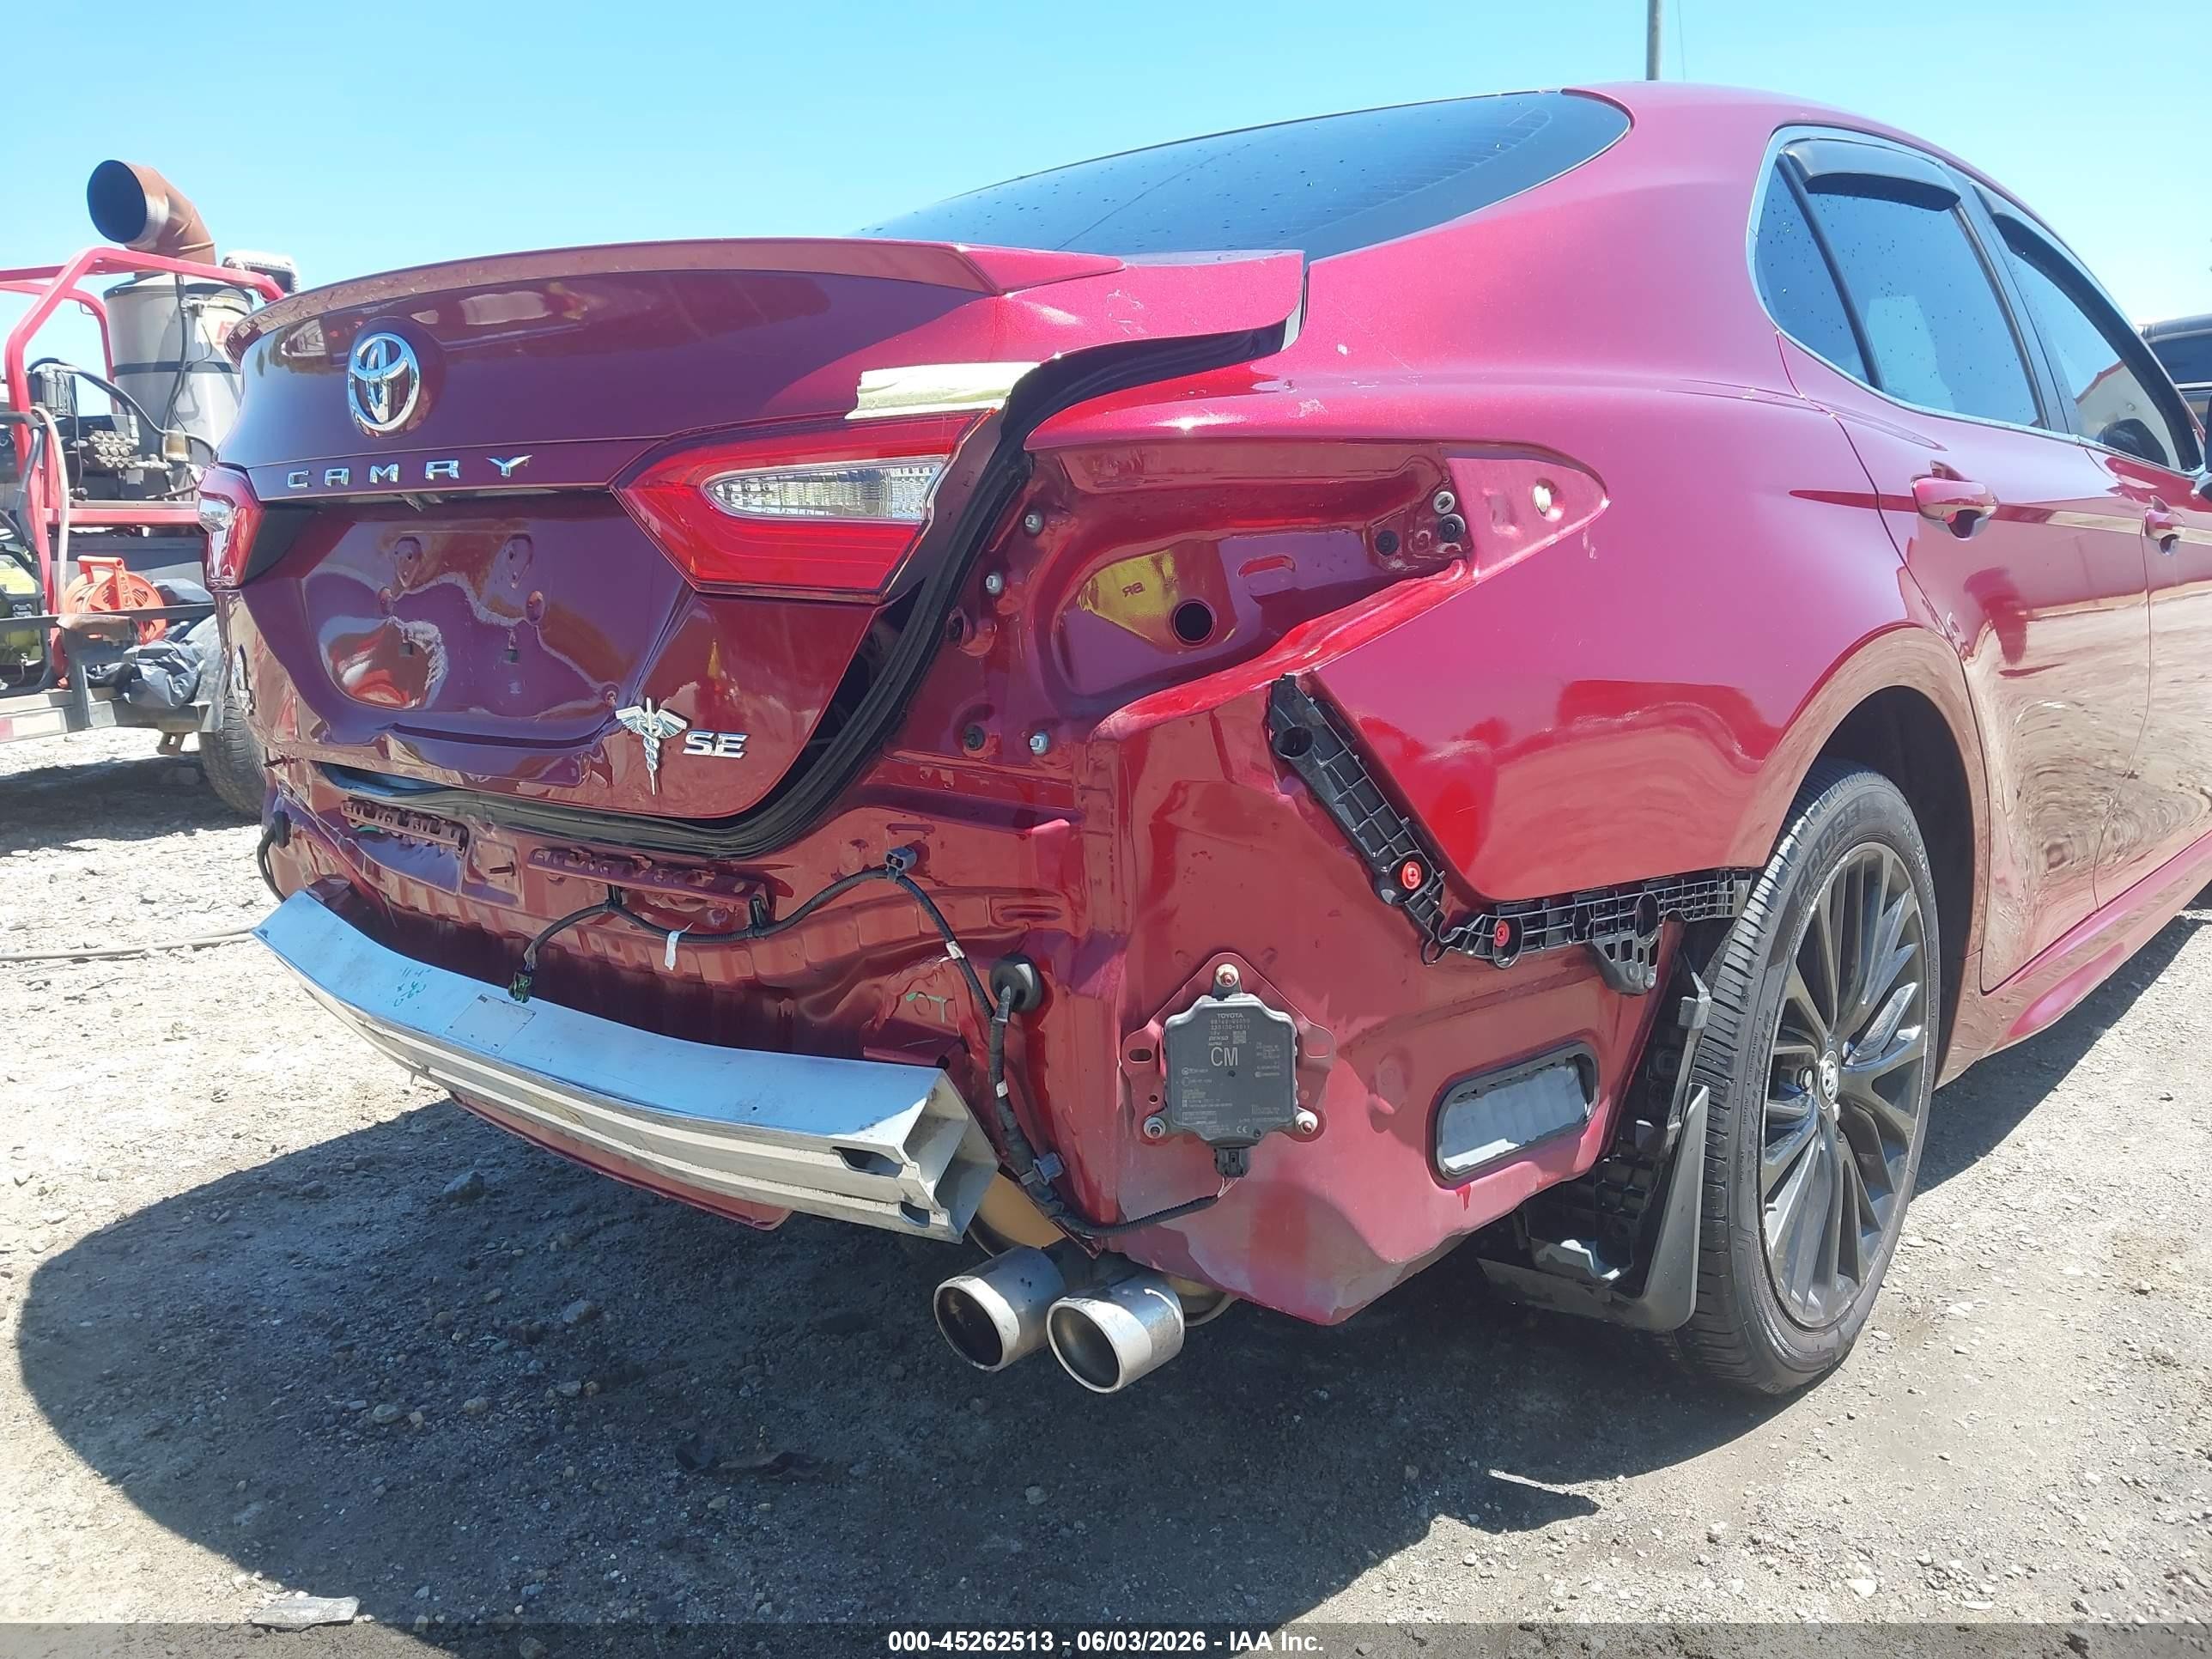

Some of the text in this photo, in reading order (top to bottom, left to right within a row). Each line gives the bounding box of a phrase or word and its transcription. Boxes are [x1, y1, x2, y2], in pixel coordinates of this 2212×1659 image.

[287, 455, 532, 488] CAMRY
[683, 731, 750, 759] SE
[1211, 1047, 1238, 1066] CM
